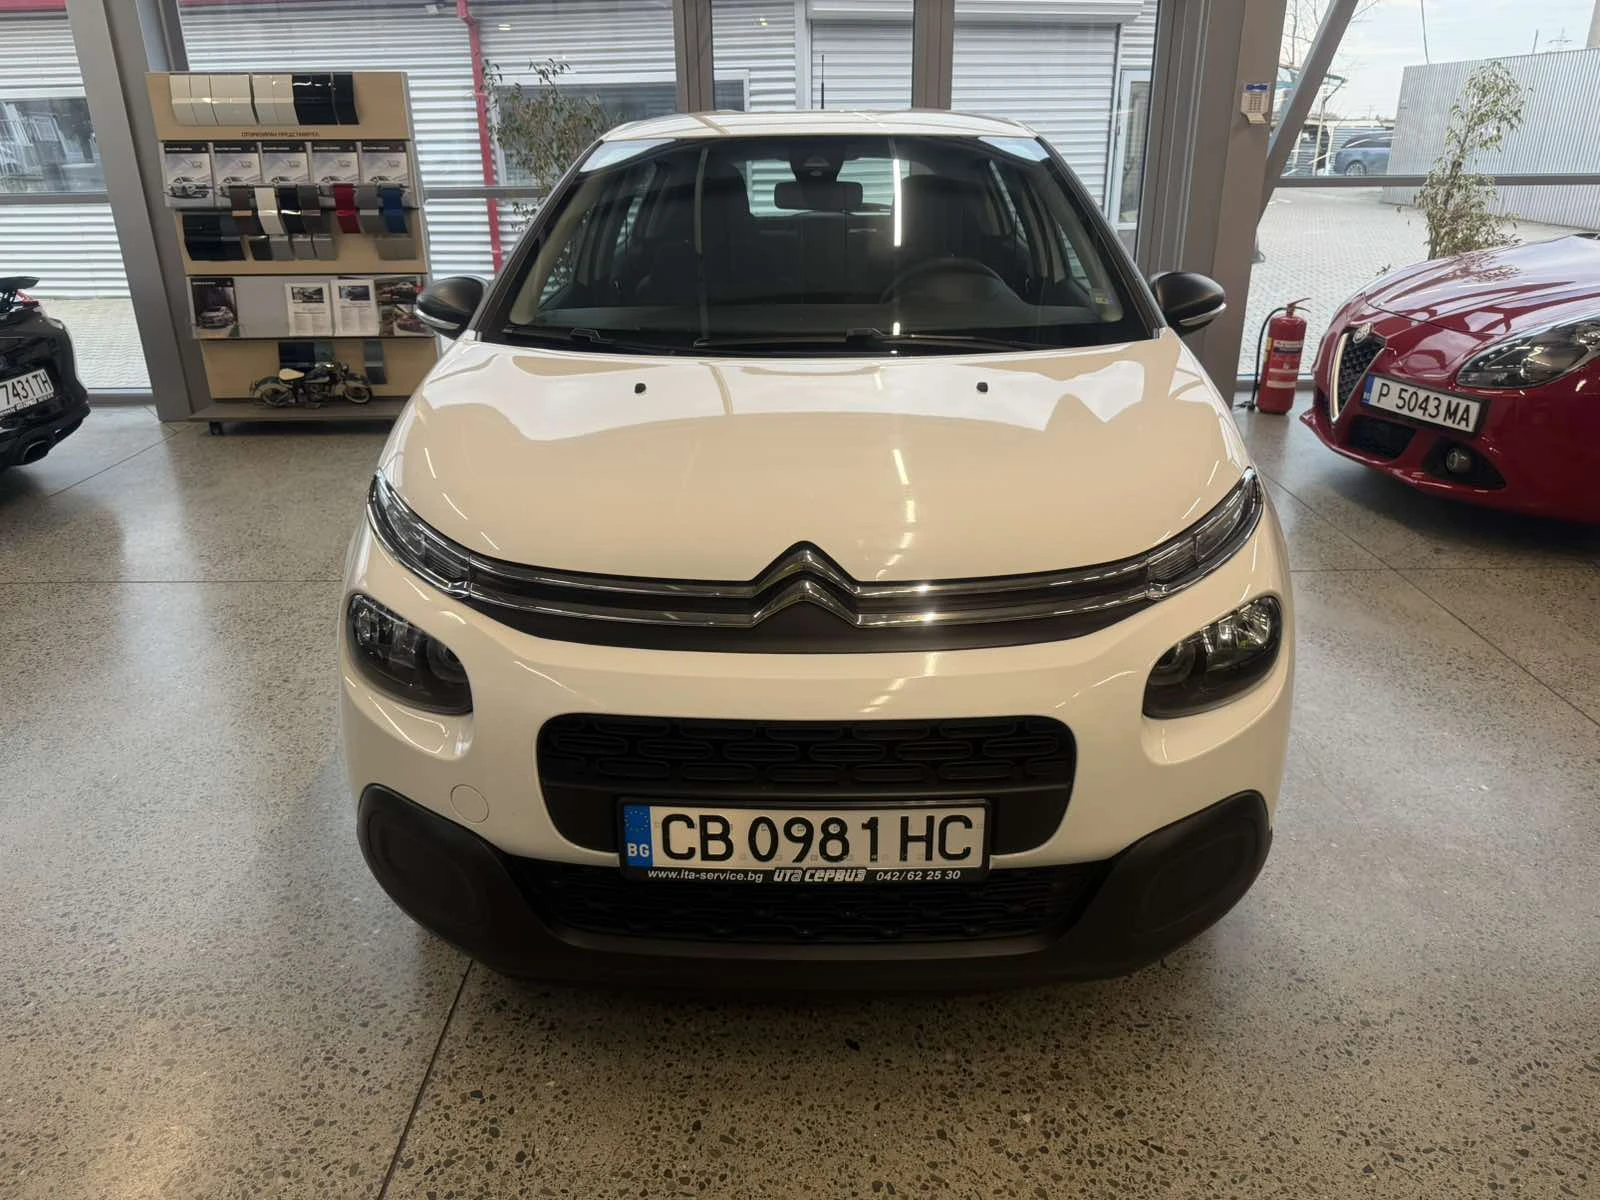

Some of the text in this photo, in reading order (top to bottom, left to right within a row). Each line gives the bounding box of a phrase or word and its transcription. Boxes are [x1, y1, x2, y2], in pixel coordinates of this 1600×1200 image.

[0, 377, 36, 405] 7431
[32, 371, 53, 393] TH
[1377, 382, 1470, 428] P 5043 MA
[627, 842, 650, 858] BG
[661, 813, 973, 863] CB 0981 HC
[647, 868, 764, 883] www.ita-service.bg
[926, 870, 942, 880] 25
[944, 870, 961, 880] 30
